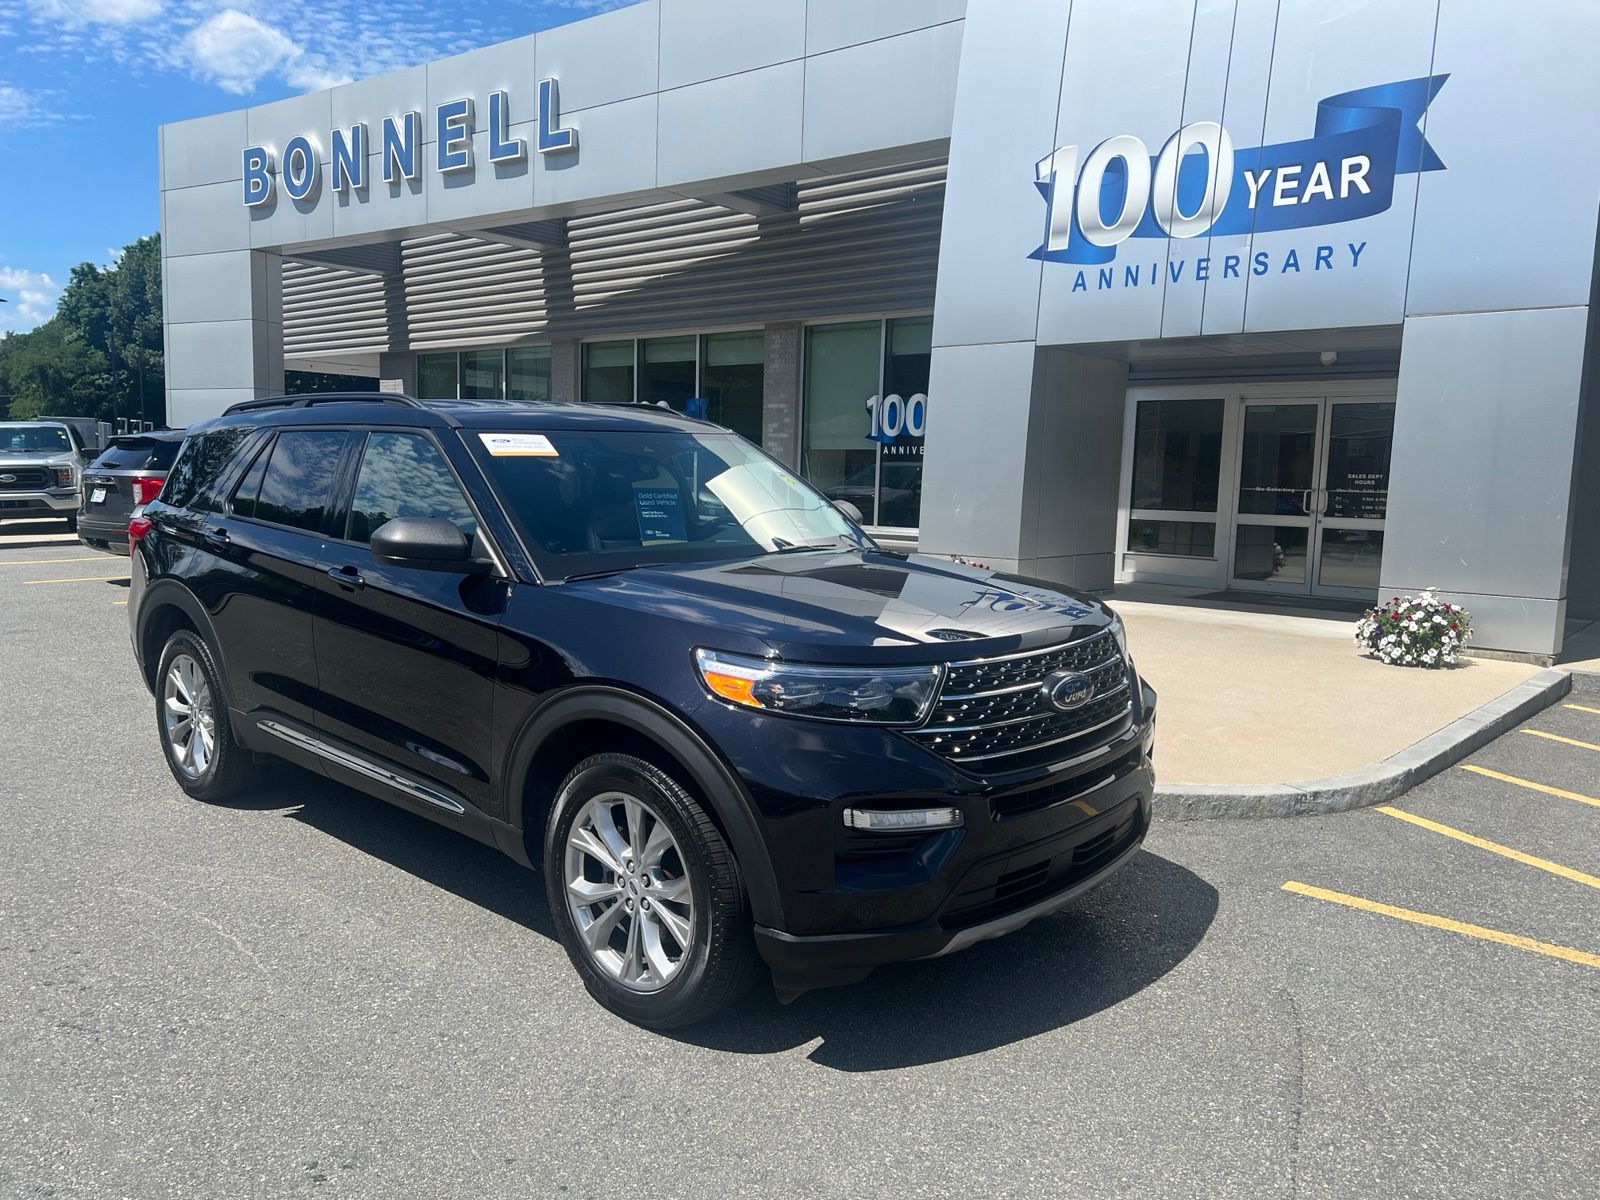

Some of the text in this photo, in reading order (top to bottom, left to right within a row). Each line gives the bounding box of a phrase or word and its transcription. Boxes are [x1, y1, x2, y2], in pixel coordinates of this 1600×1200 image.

[242, 78, 578, 207] BONNELL
[1035, 120, 1371, 251] 100 YEAR
[1072, 241, 1367, 293] ANNIVERSARY
[865, 393, 929, 437] 100
